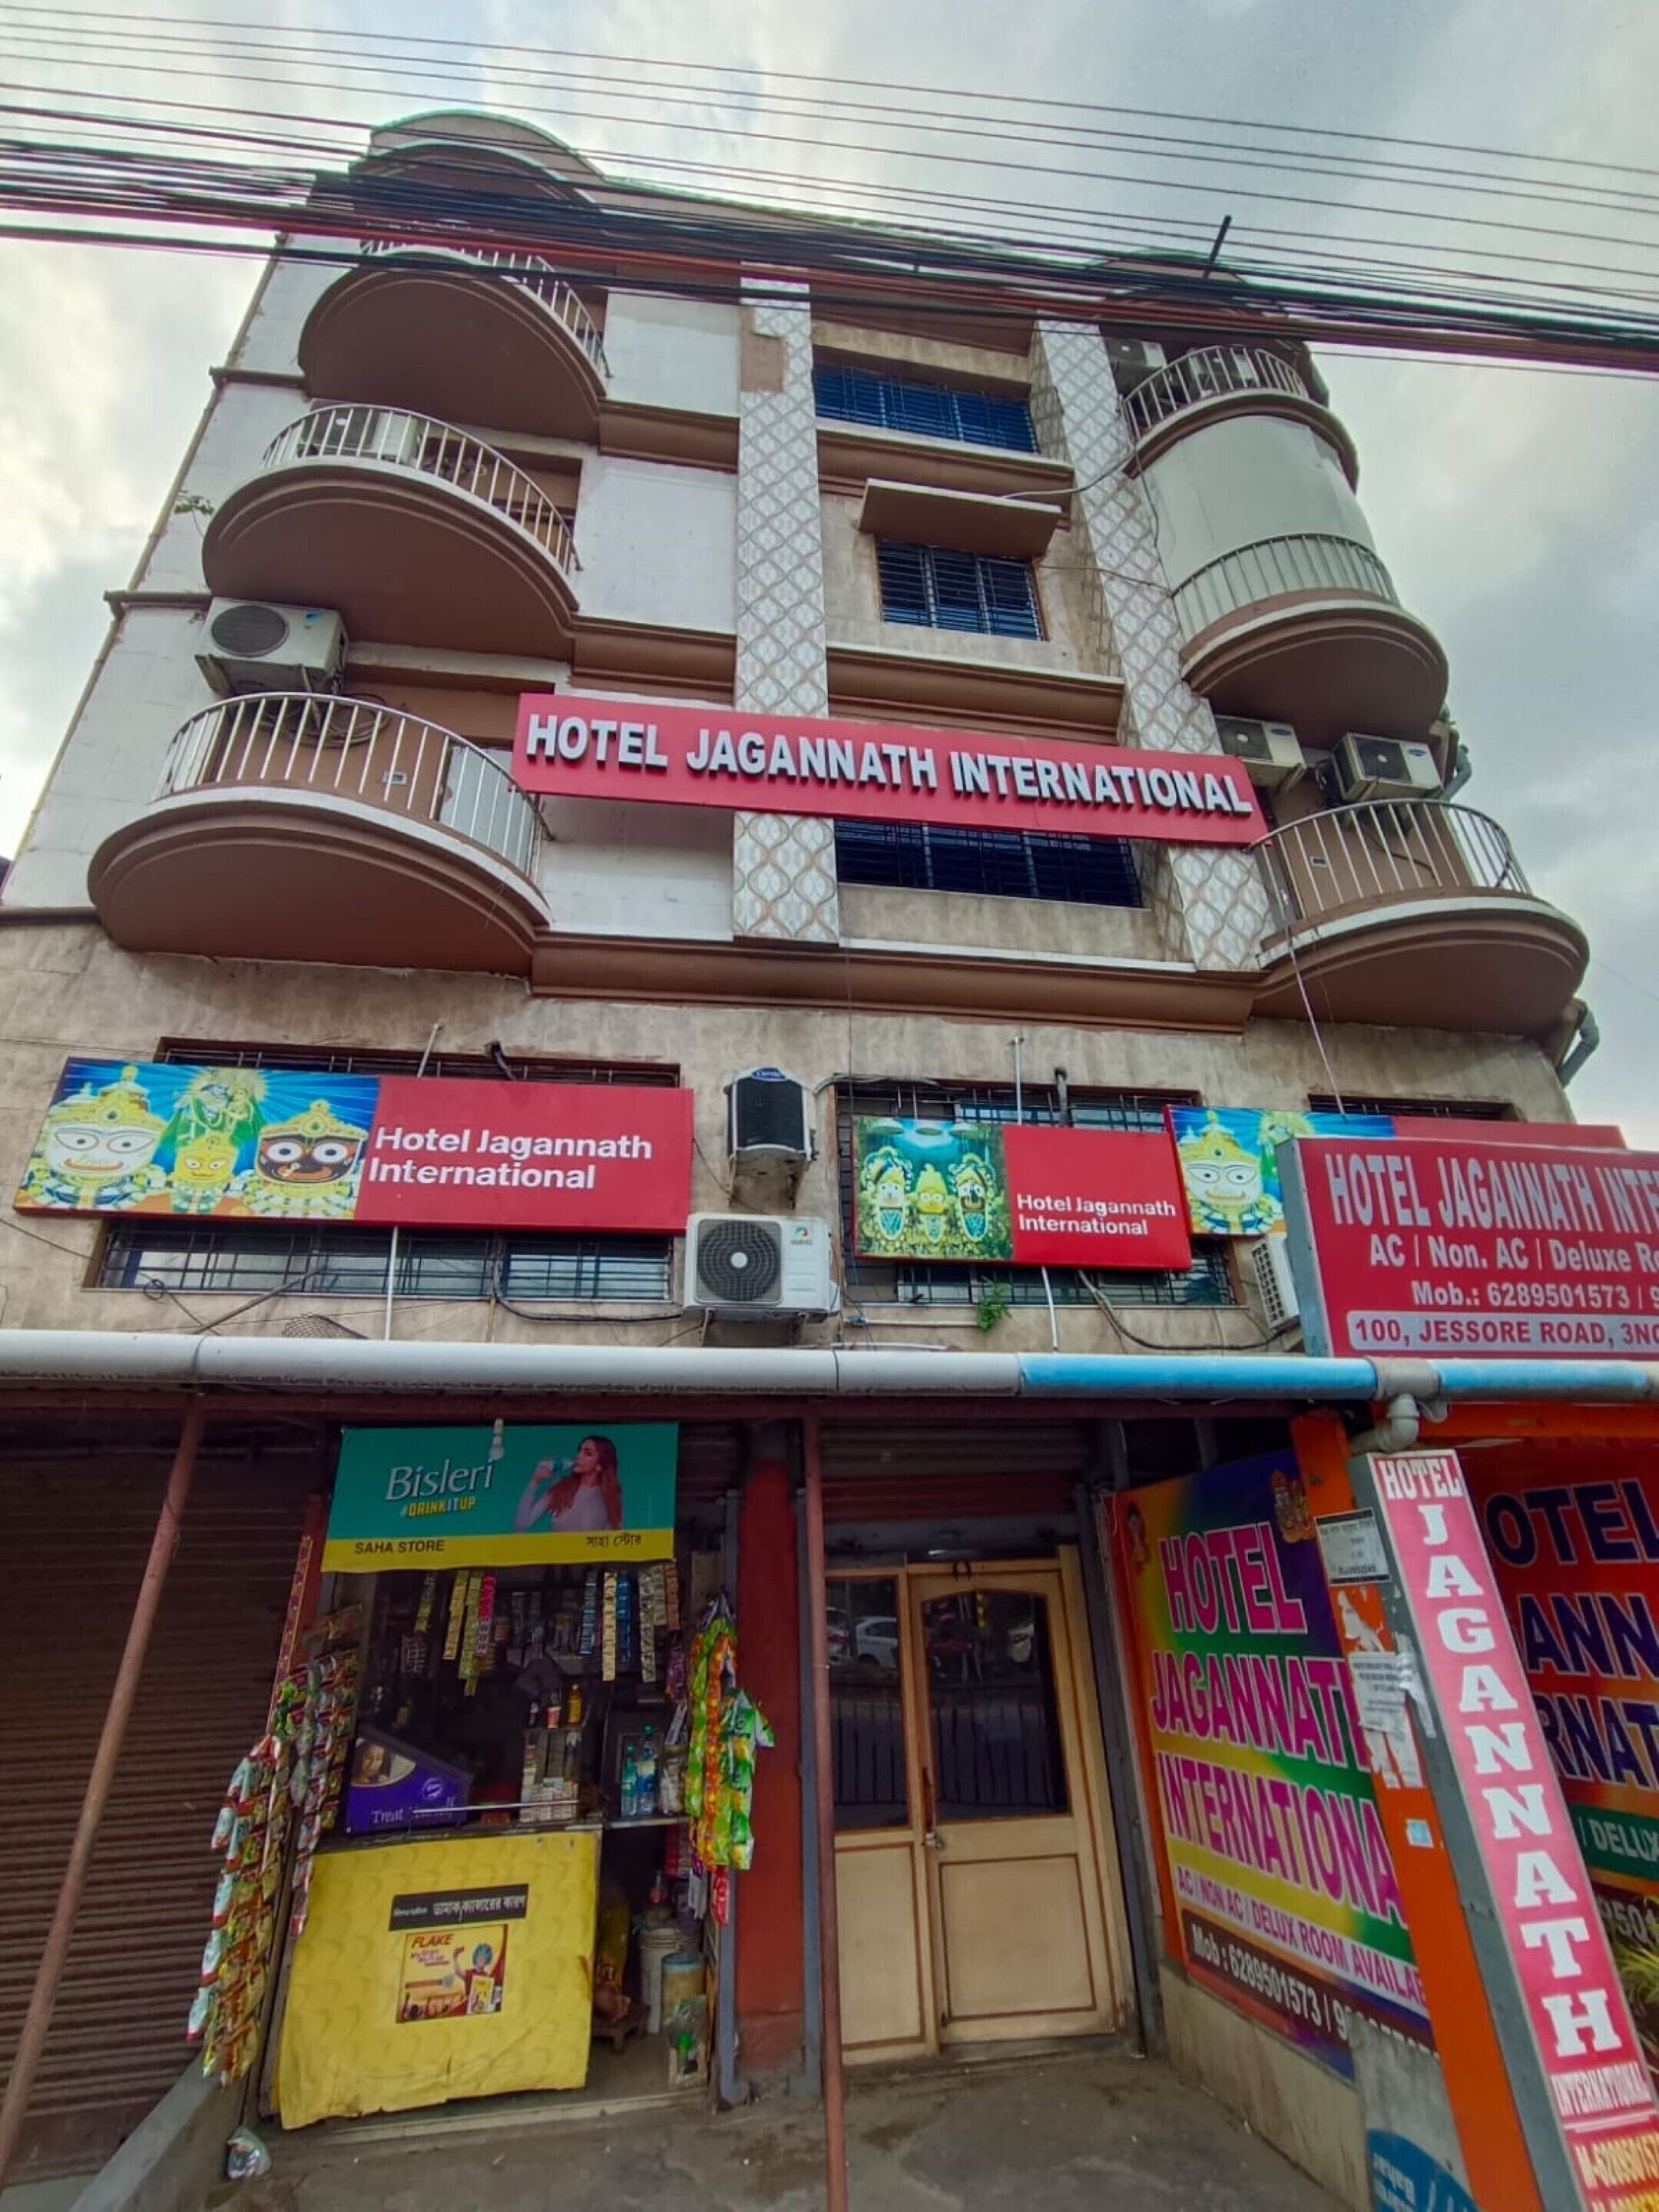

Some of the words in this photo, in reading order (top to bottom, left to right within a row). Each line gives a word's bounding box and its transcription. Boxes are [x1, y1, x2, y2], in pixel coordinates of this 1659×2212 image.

[525, 713, 668, 768] HOTEL
[685, 726, 939, 791] JAGANNATH
[949, 750, 1255, 816] INTERNATIONAL
[374, 1127, 471, 1153] Hotel
[476, 1130, 653, 1161] Jagannath
[368, 1157, 595, 1189] International
[1016, 1194, 1072, 1213] Hotel
[1075, 1197, 1177, 1217] Jagannath
[1323, 1153, 1432, 1227] HOTEL
[1437, 1156, 1604, 1233] JAGANNATH
[1594, 1166, 1659, 1235] INTE
[1018, 1214, 1149, 1236] International
[1369, 1233, 1406, 1267] AC
[1428, 1235, 1488, 1270] Non.
[1495, 1237, 1529, 1270] AC
[1548, 1239, 1632, 1273] Deluxe
[1487, 1282, 1631, 1309] 6289501573
[1356, 1318, 1410, 1348] 100,
[1419, 1320, 1532, 1343] JESSORE
[1541, 1321, 1614, 1349] ROAD,
[386, 1458, 497, 1501] Bisleri
[1377, 1458, 1463, 1500] HOTEL
[1484, 1478, 1659, 1568] OTEL
[355, 1541, 393, 1555] SAHA
[398, 1539, 445, 1554] STORE
[1158, 1522, 1309, 1635] HOTEL
[1154, 1751, 1409, 1929] INTERNATIONA
[411, 1933, 454, 1949] FLAKE
[1250, 1899, 1299, 1949] DELUX
[1297, 1920, 1350, 1974] ROOM
